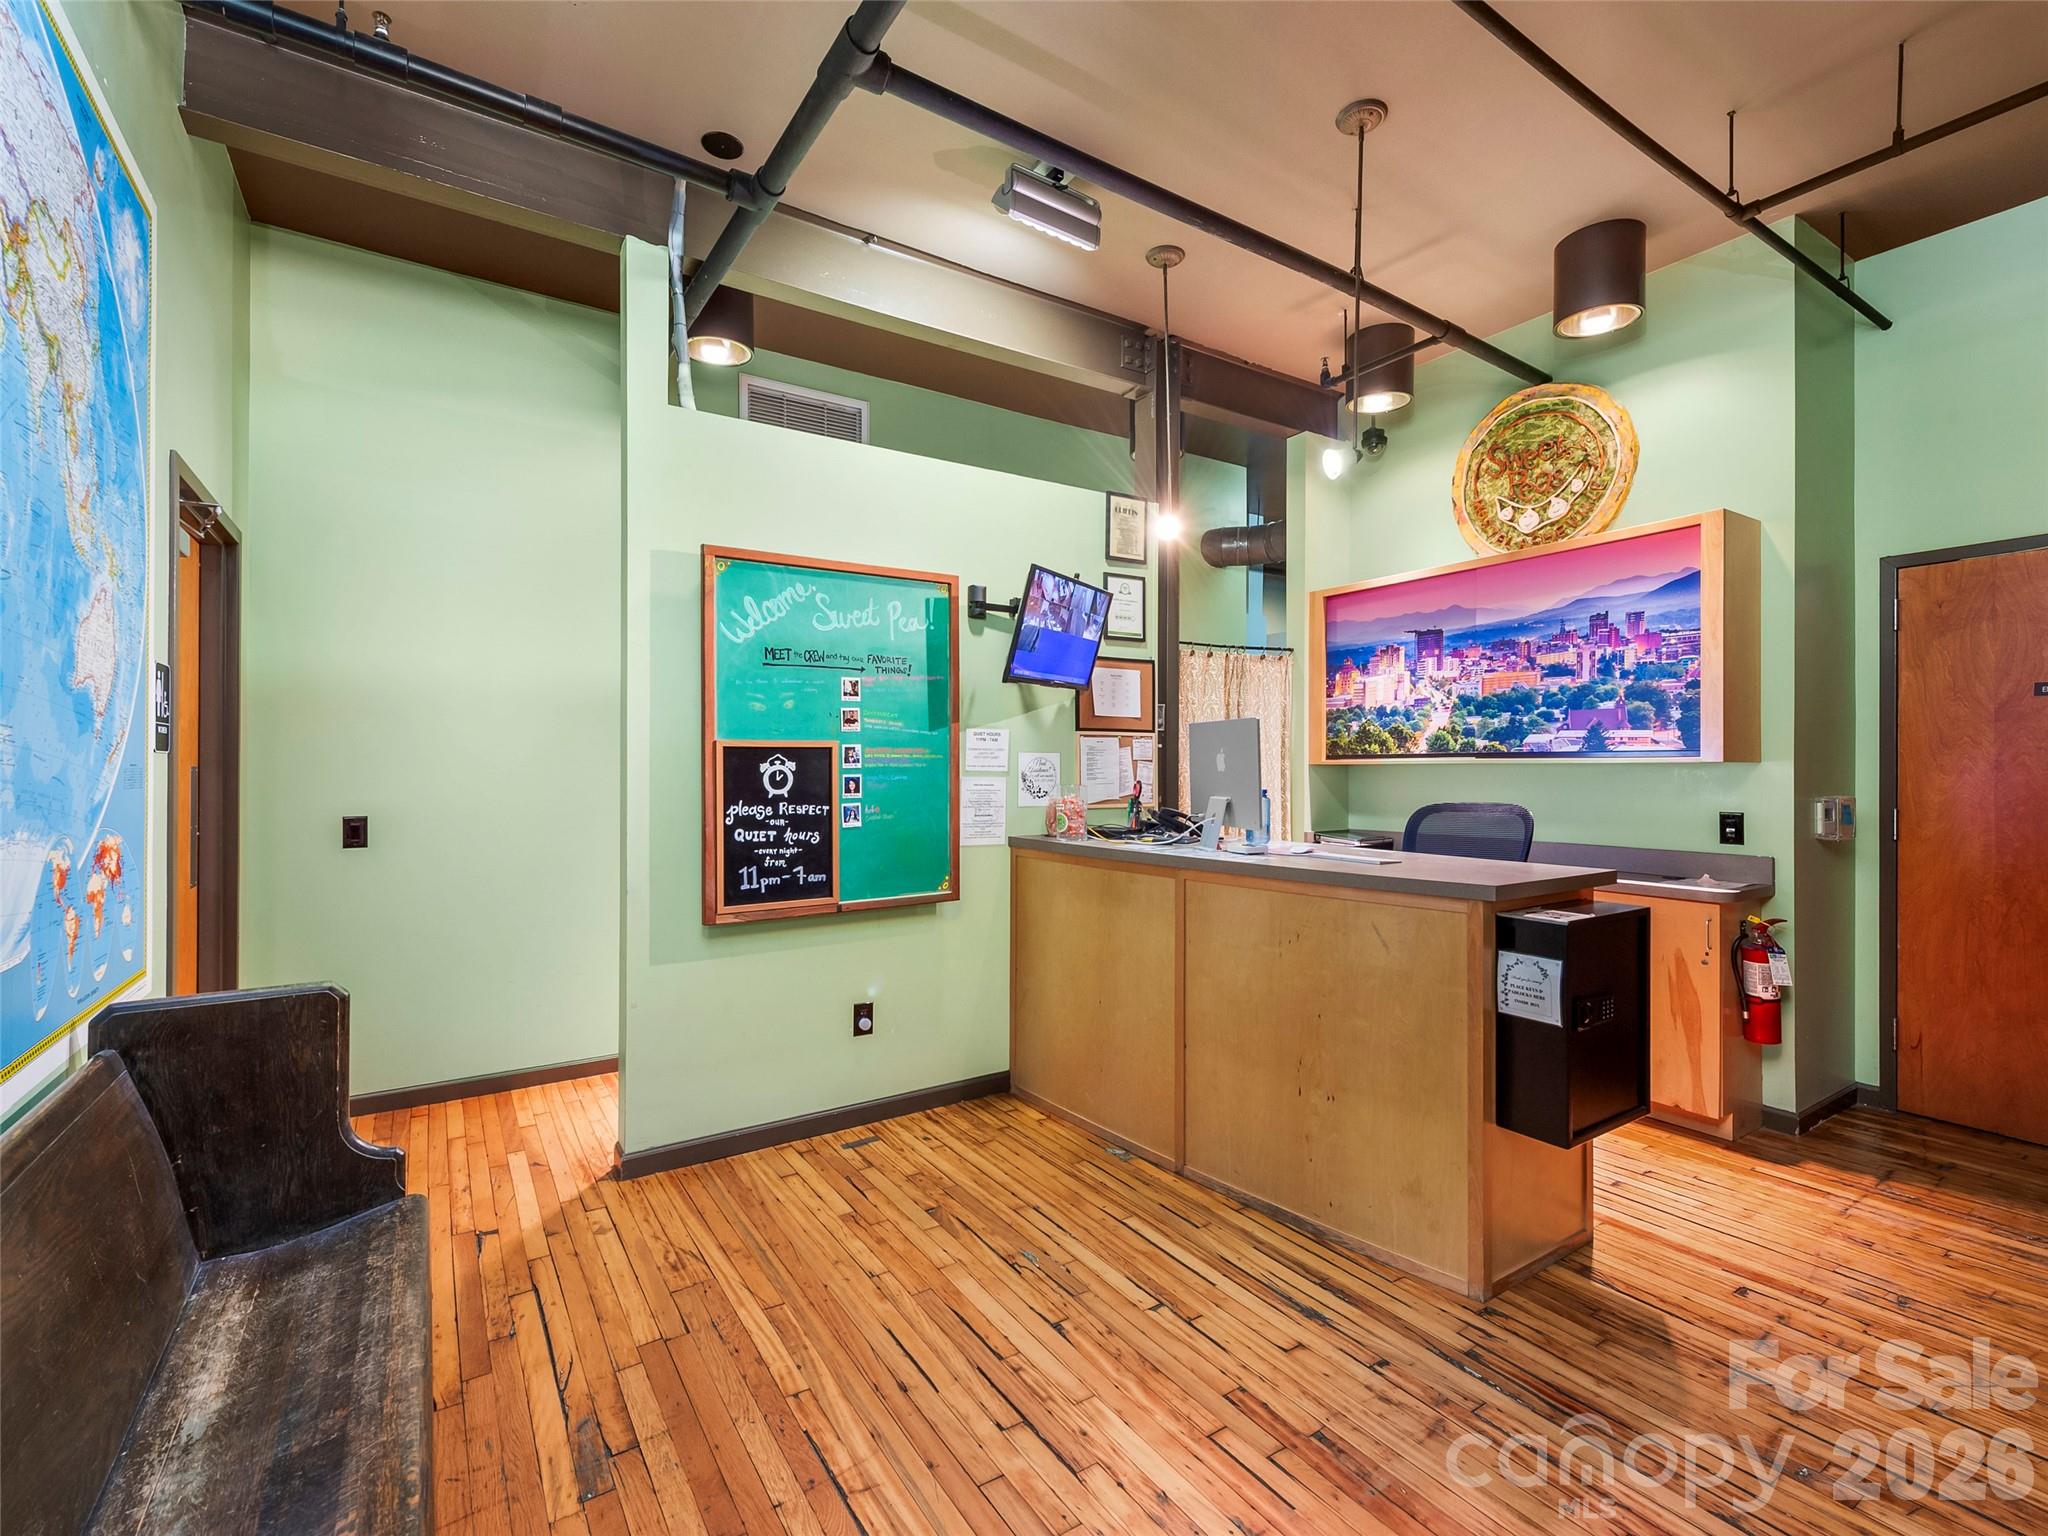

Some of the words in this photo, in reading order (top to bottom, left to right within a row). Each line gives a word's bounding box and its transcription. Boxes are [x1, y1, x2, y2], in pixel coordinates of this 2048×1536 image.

[1486, 432, 1567, 479] Sweet
[1507, 468, 1565, 500] Peas
[811, 592, 880, 632] Sweet
[887, 597, 935, 641] Pea!
[764, 646, 792, 662] MEET
[803, 649, 825, 663] CREW
[867, 653, 908, 665] FAVORITE
[875, 664, 912, 677] THINGS!
[725, 800, 773, 825] please
[778, 802, 830, 816] RESPECT
[734, 828, 777, 842] QUIET
[783, 827, 820, 844] hours
[764, 856, 787, 867] from
